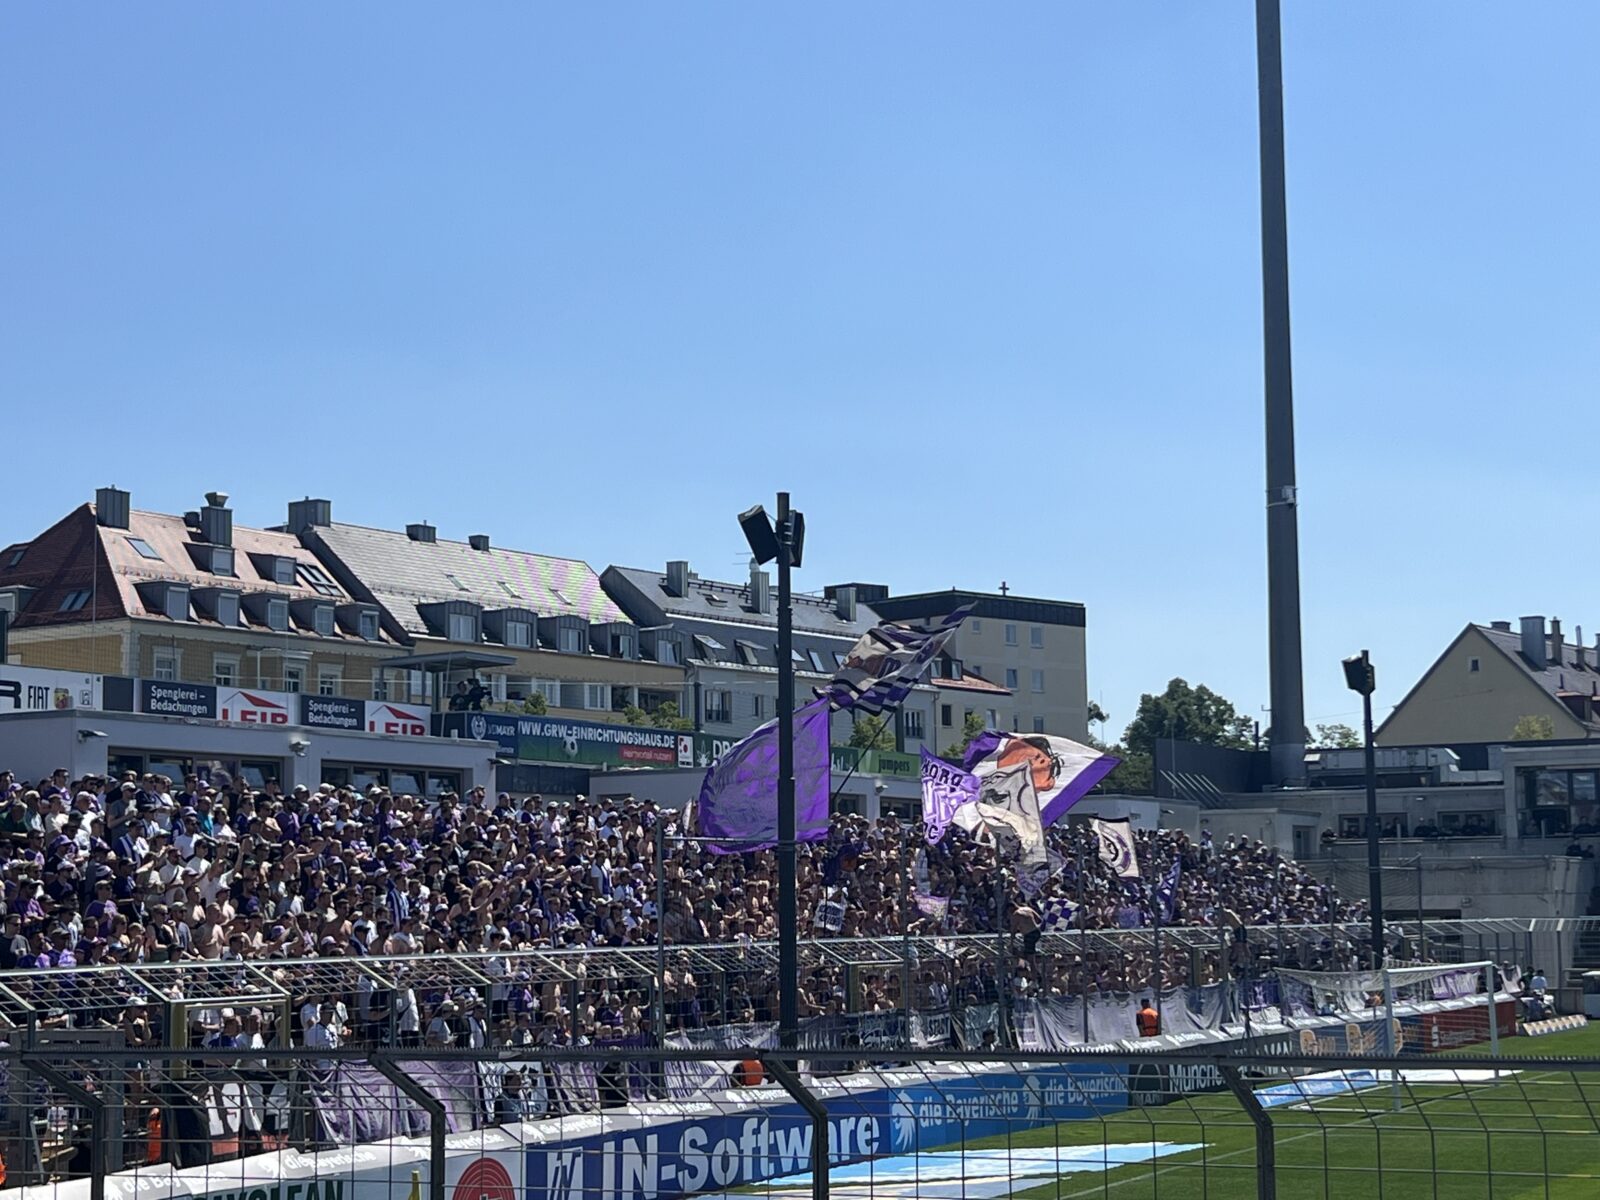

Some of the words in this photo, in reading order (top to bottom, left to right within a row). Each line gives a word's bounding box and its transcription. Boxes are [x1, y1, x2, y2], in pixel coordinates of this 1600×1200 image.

[28, 685, 50, 710] FIAT
[150, 699, 208, 716] Bedachungen
[308, 712, 358, 728] Bedachungen
[878, 754, 910, 775] jumpers
[1044, 1079, 1064, 1105] die
[919, 1098, 942, 1128] die
[946, 1090, 1019, 1126] Bayerische
